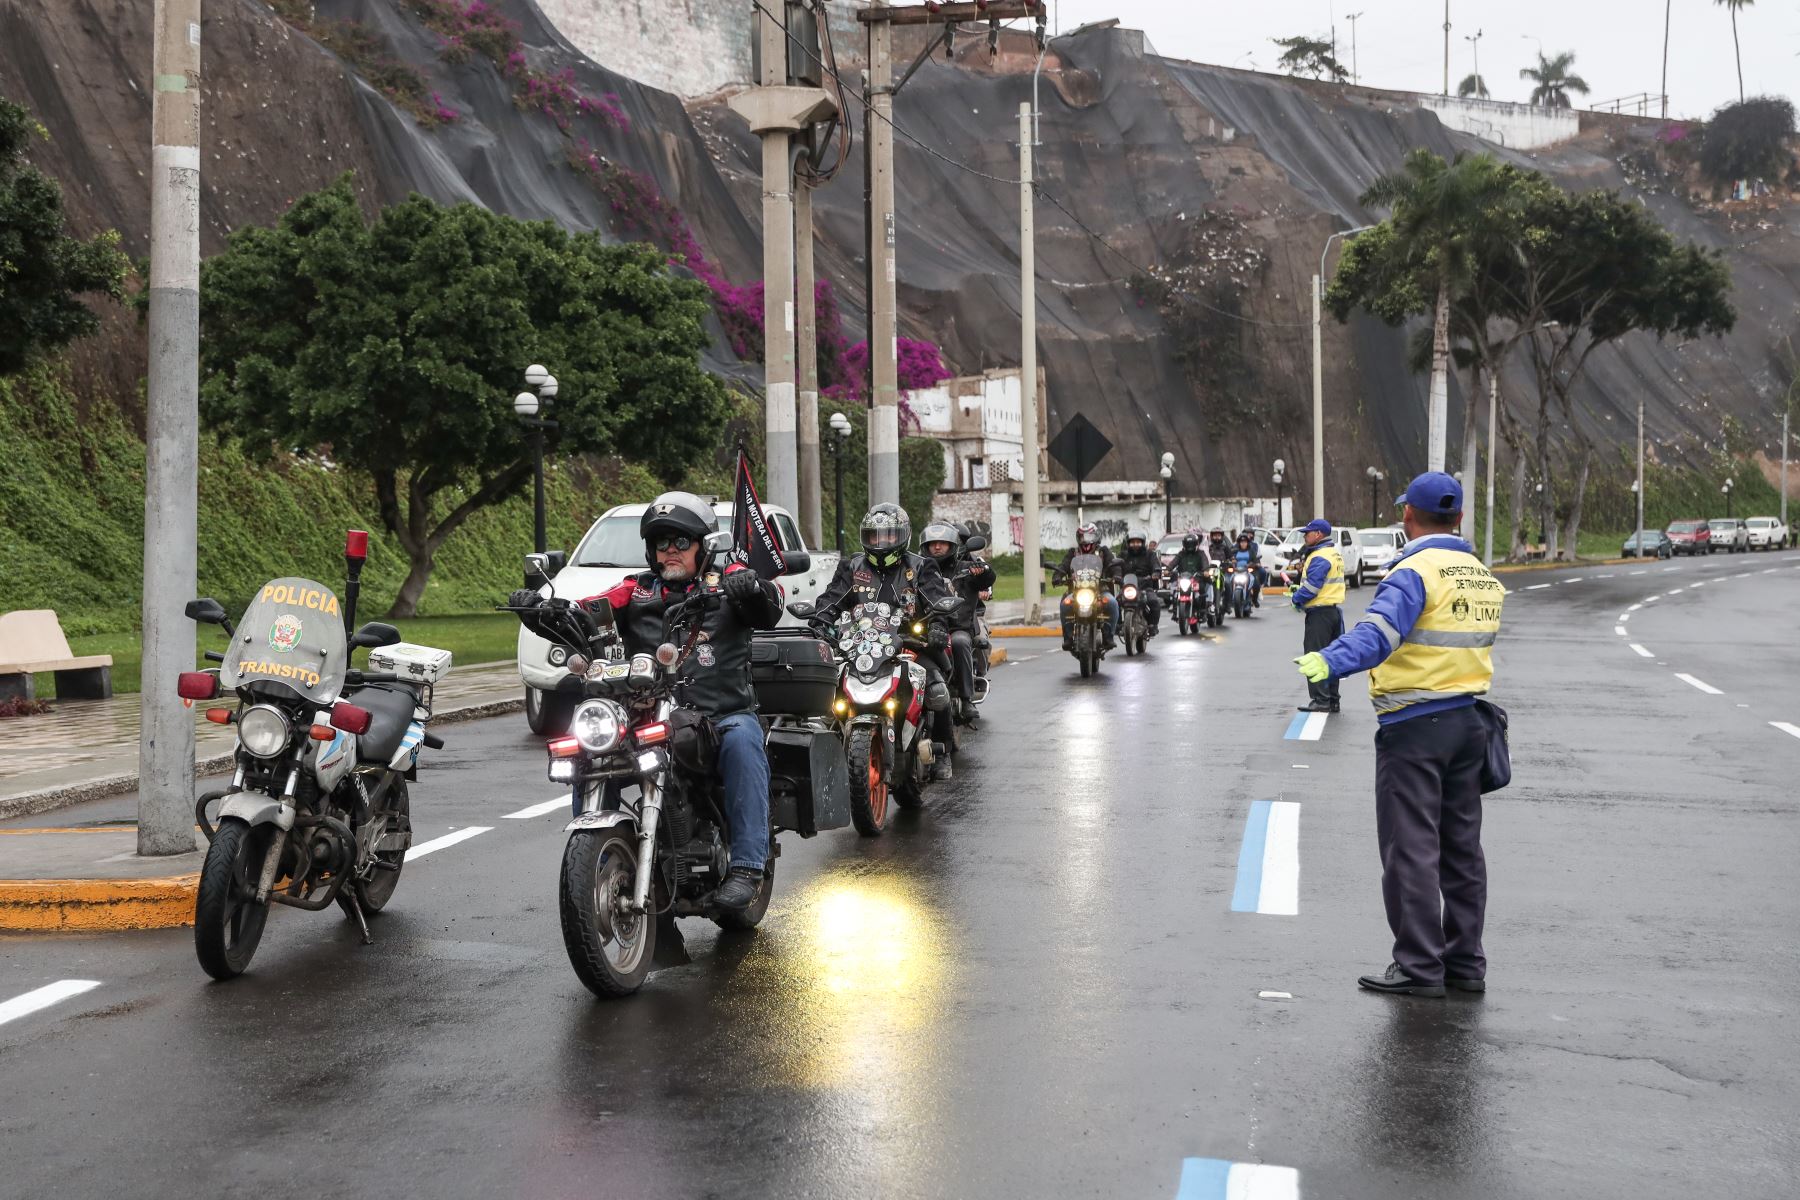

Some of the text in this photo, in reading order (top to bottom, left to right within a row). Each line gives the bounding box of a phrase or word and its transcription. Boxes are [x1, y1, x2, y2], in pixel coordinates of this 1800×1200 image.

[748, 504, 766, 535] MOTERA
[762, 535, 773, 551] DEL
[1439, 566, 1474, 579] INSPECTOR
[1456, 580, 1465, 589] DE
[261, 585, 338, 618] POLICIA
[1474, 607, 1500, 622] LIMA
[239, 661, 320, 685] TRANSITO
